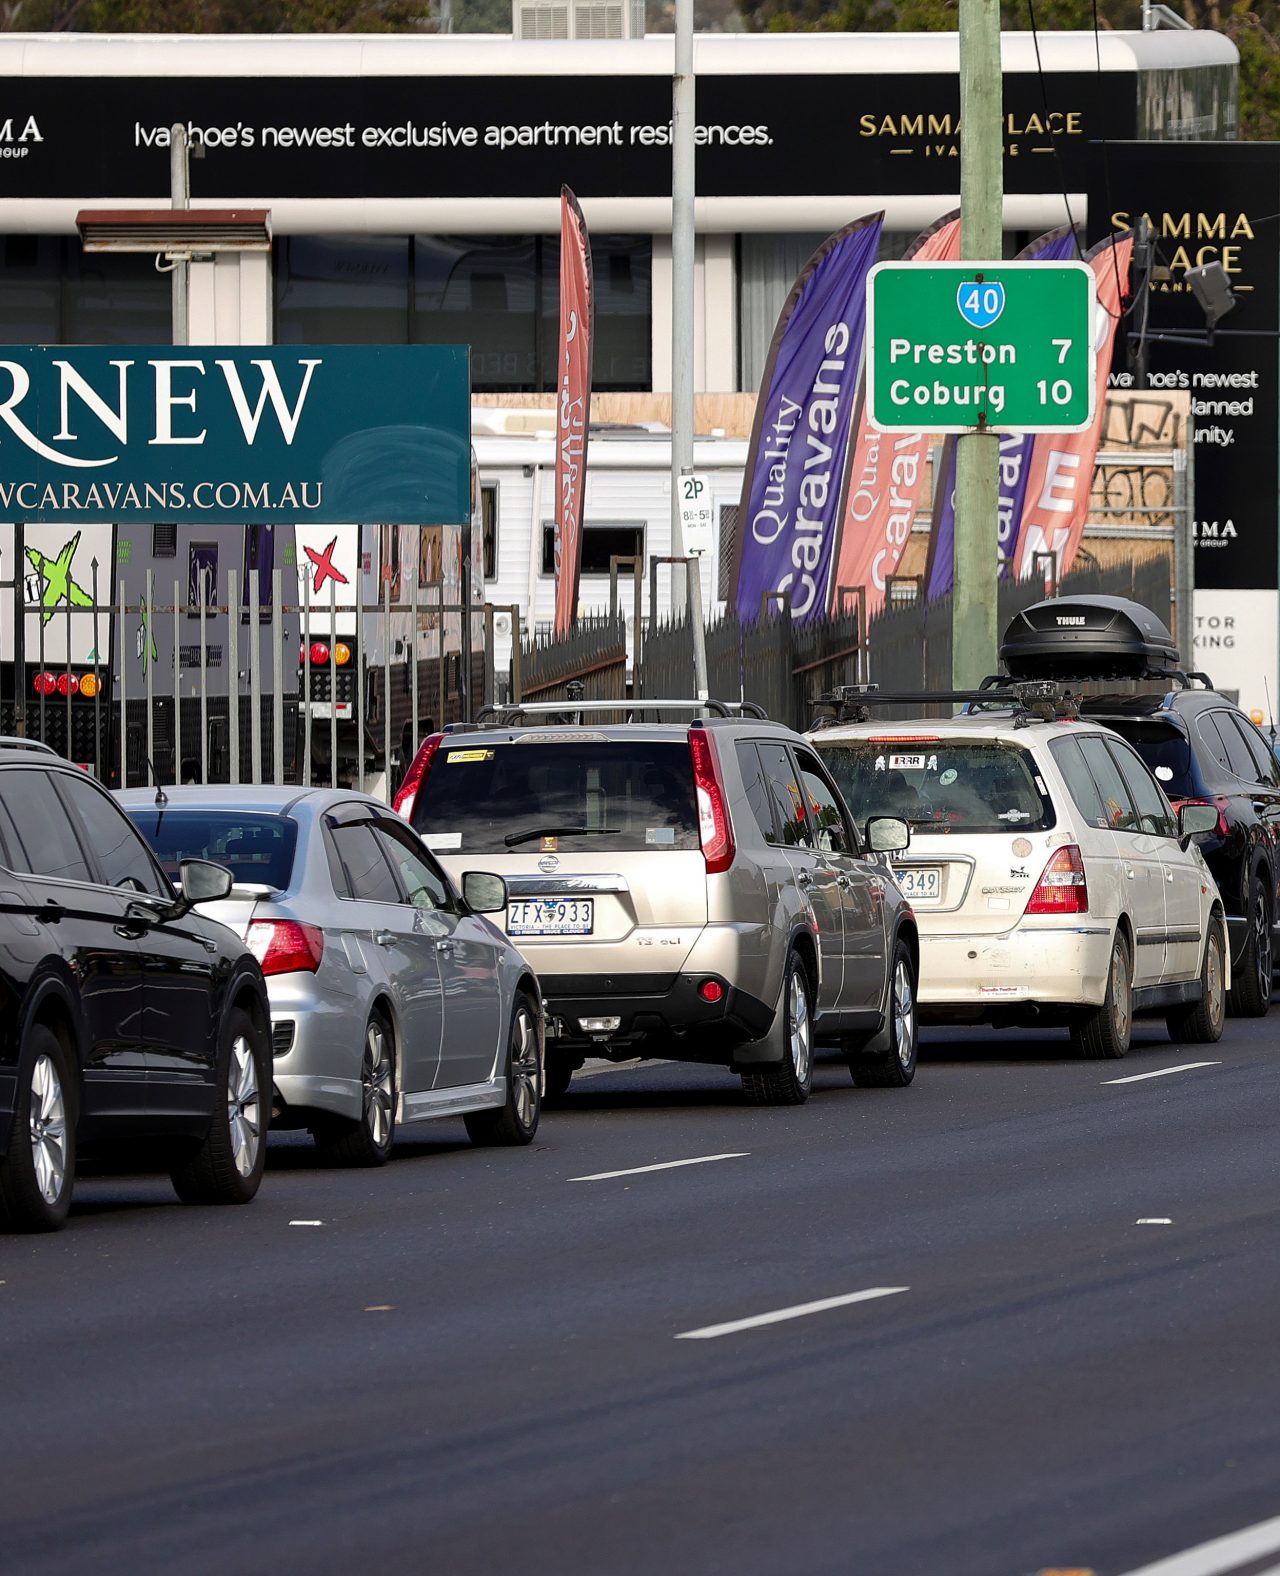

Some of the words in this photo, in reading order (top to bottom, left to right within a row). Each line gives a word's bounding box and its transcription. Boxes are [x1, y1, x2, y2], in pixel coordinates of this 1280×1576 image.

[135, 121, 254, 147] Ivahoe's
[262, 122, 355, 148] newest
[361, 120, 478, 147] exclusive
[484, 121, 623, 150] apartment
[630, 120, 774, 146] resiences.
[859, 114, 961, 137] SAMM
[1001, 112, 1083, 135] LACE
[964, 289, 999, 314] 40
[890, 338, 1017, 364] Preston
[1051, 338, 1073, 364] 7
[1192, 371, 1259, 388] newest
[890, 379, 1005, 413] Coburg
[1036, 379, 1073, 405] 10
[1192, 397, 1253, 416] lanned
[752, 394, 803, 545] Quality
[776, 321, 850, 619] Caravans
[851, 432, 881, 522] Qual
[683, 480, 704, 500] 2P
[1056, 616, 1086, 625] THULE
[906, 873, 936, 890] 349
[510, 904, 543, 924] ZFX
[558, 903, 590, 923] 933
